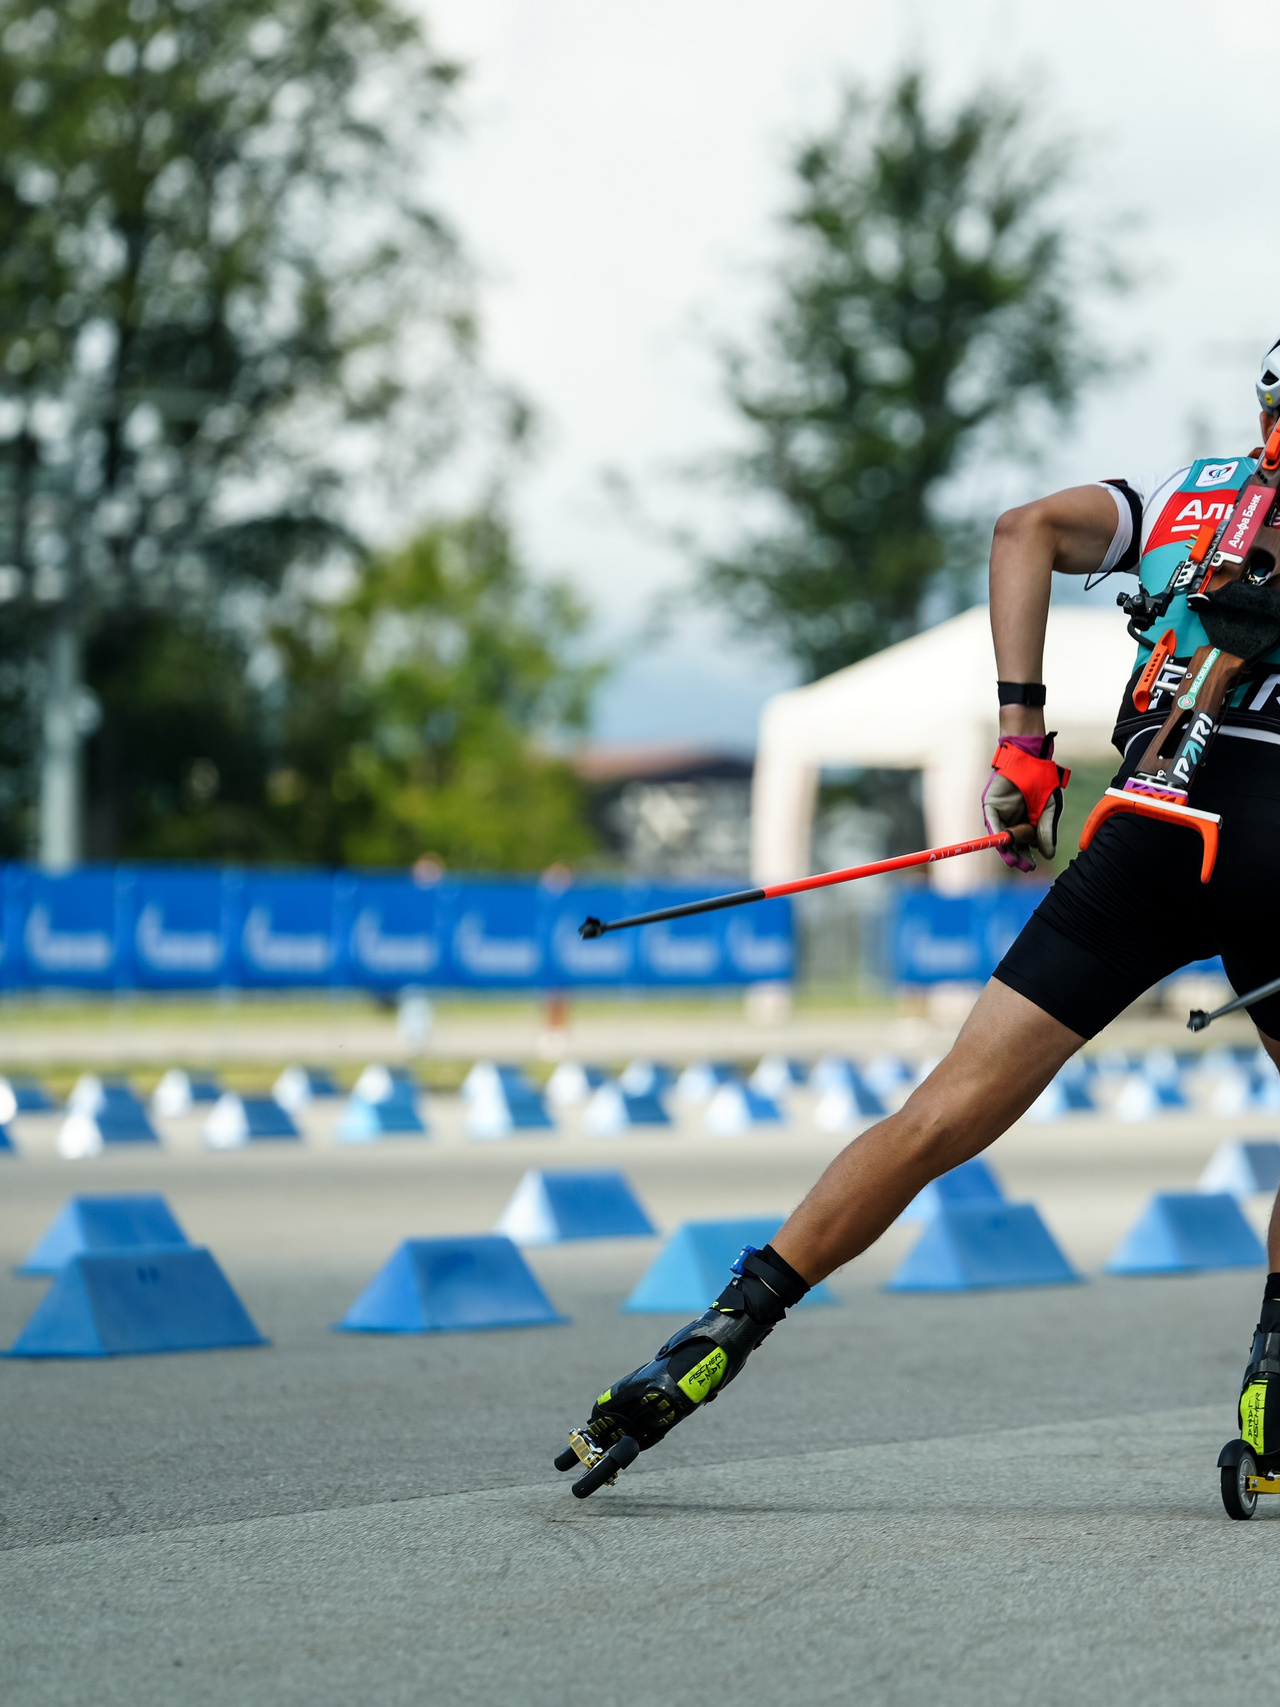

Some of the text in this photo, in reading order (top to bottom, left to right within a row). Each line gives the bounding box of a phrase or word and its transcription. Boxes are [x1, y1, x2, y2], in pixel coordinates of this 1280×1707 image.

[1228, 494, 1262, 549] Альфа Банк
[1173, 712, 1214, 783] PARI
[688, 1352, 722, 1385] FISCHER
[1253, 1392, 1261, 1446] FISCHER
